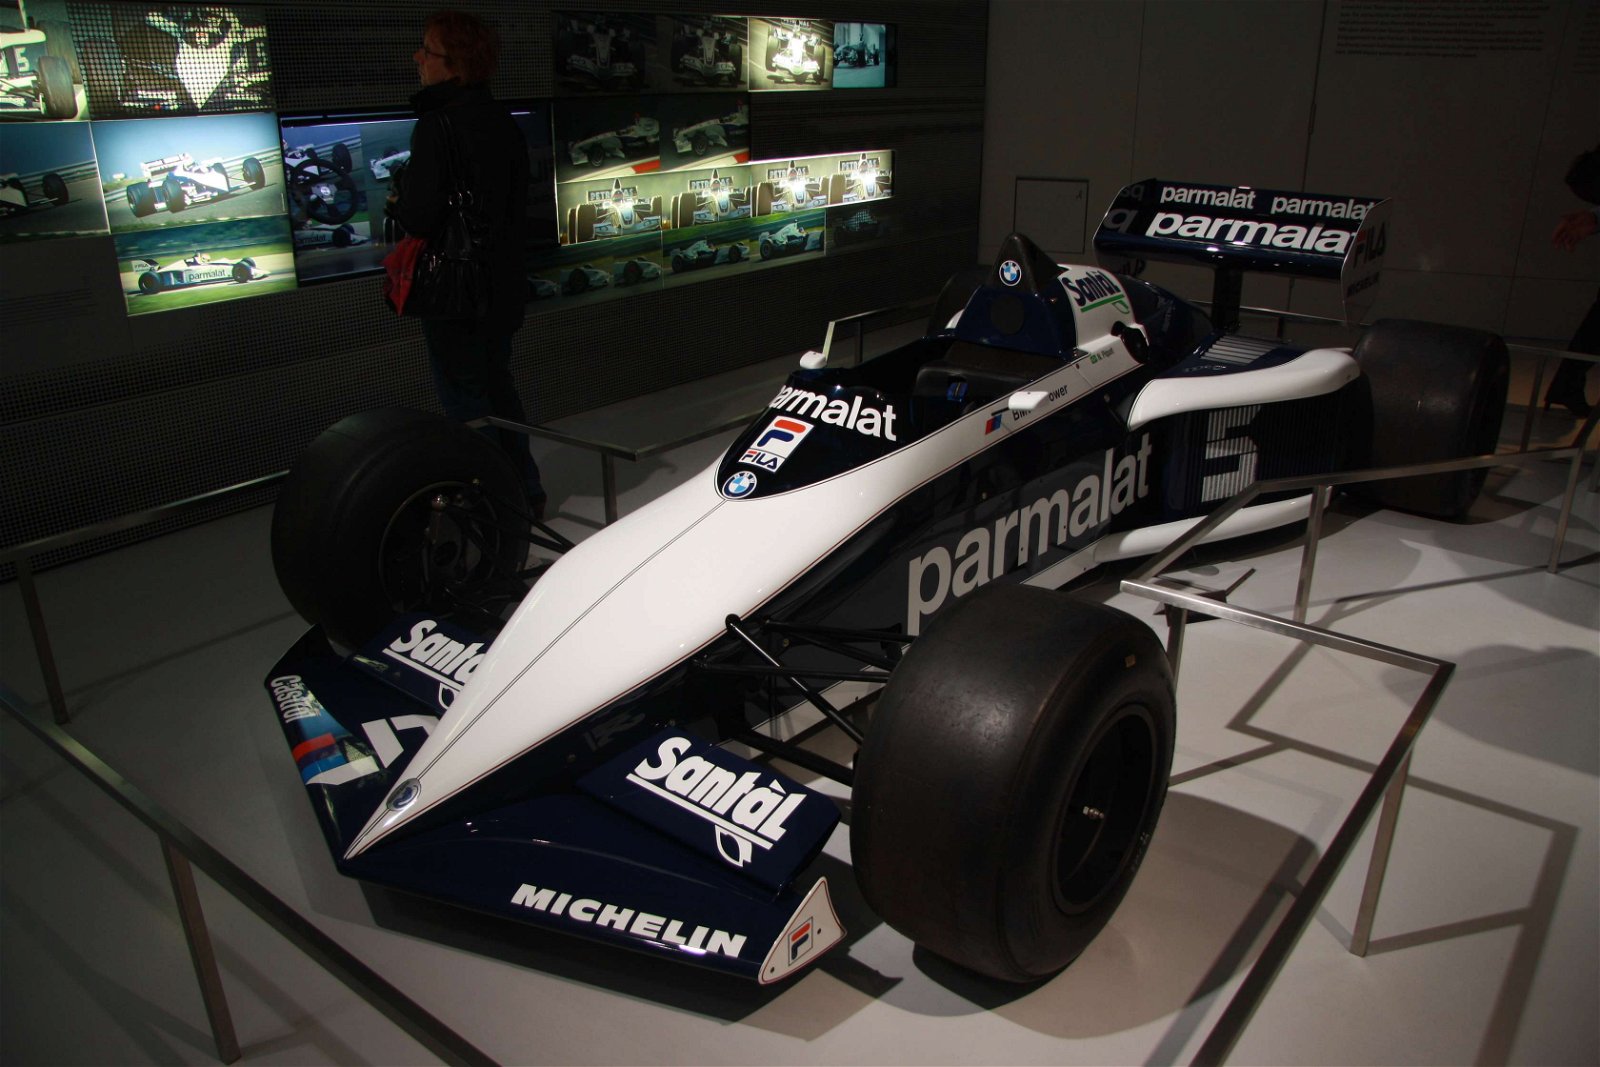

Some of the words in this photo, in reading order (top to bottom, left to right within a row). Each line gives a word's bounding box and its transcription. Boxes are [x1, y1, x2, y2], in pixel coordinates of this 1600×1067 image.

[590, 188, 634, 200] PETRAS
[690, 178, 730, 190] PETRAS
[1160, 186, 1257, 210] parmalat
[1145, 211, 1357, 254] parmala
[188, 269, 226, 281] parmalat
[1048, 385, 1068, 402] ower
[769, 385, 897, 441] armalat
[741, 450, 778, 471] FILA
[1200, 404, 1262, 502] 5
[906, 432, 1153, 637] parmalat
[510, 883, 748, 958] MICHELIN
